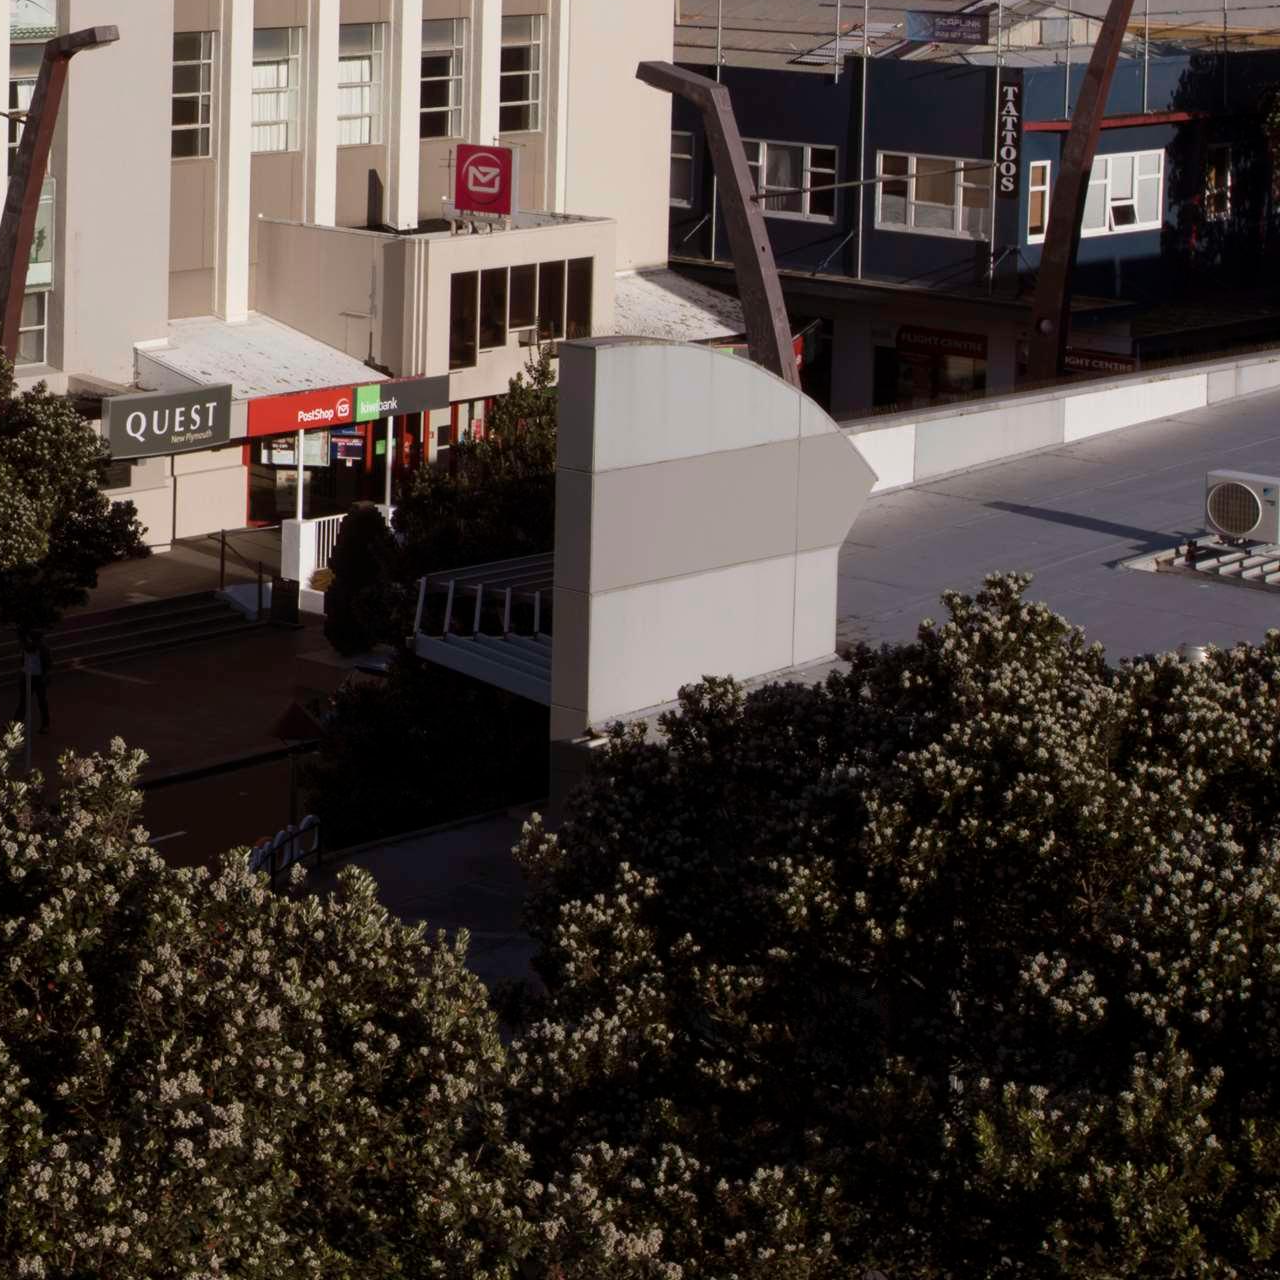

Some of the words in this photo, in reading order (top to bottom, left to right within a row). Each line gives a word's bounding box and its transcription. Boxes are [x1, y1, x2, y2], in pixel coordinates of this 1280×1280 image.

[1000, 86, 1019, 192] TATTOOS
[901, 330, 940, 345] FLIGHT
[940, 336, 984, 352] CENTRE
[1065, 355, 1090, 367] IGHT
[1091, 359, 1133, 372] CENTRE
[360, 395, 398, 415] kiwibank
[126, 401, 217, 442] QUEST
[297, 408, 334, 423] PostShop
[171, 434, 186, 444] New
[185, 429, 213, 443] Plymouth
